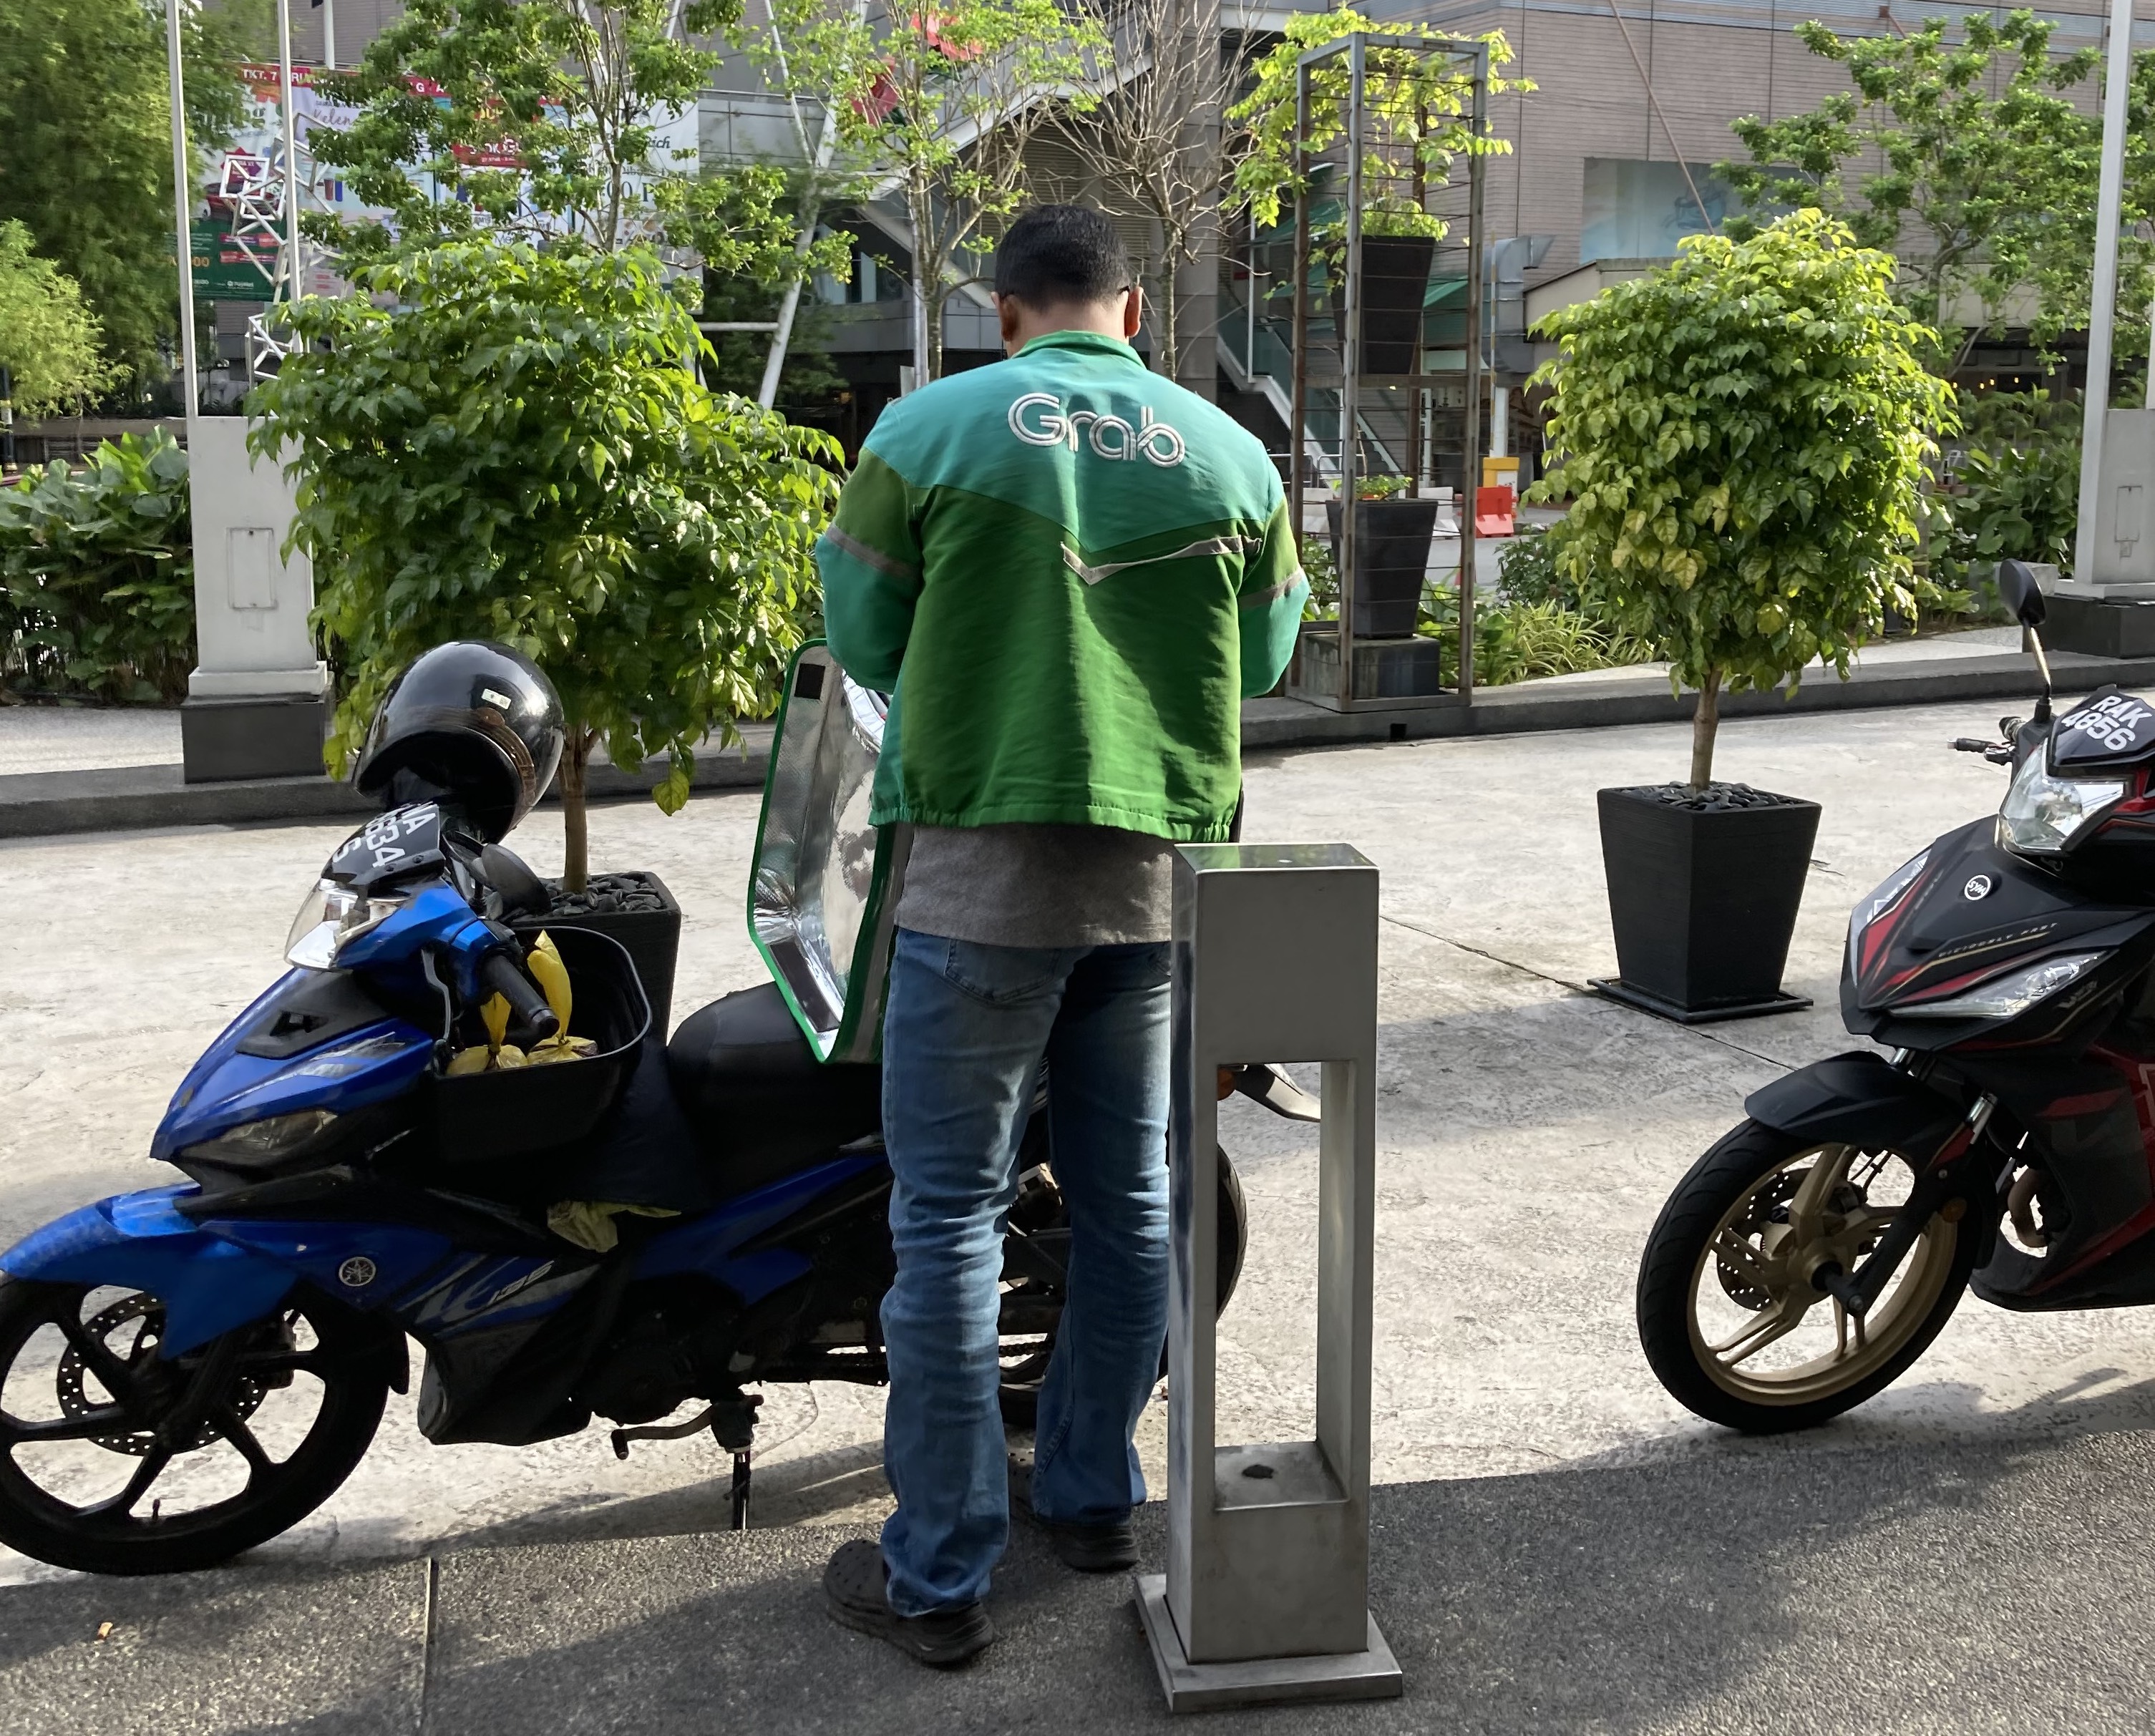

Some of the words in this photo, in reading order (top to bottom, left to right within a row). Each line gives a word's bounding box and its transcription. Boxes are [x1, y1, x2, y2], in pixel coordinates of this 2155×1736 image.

[1008, 392, 1185, 468] Grab
[2061, 708, 2136, 751] 4856
[2090, 695, 2153, 729] RAK
[1967, 880, 1987, 894] SYM
